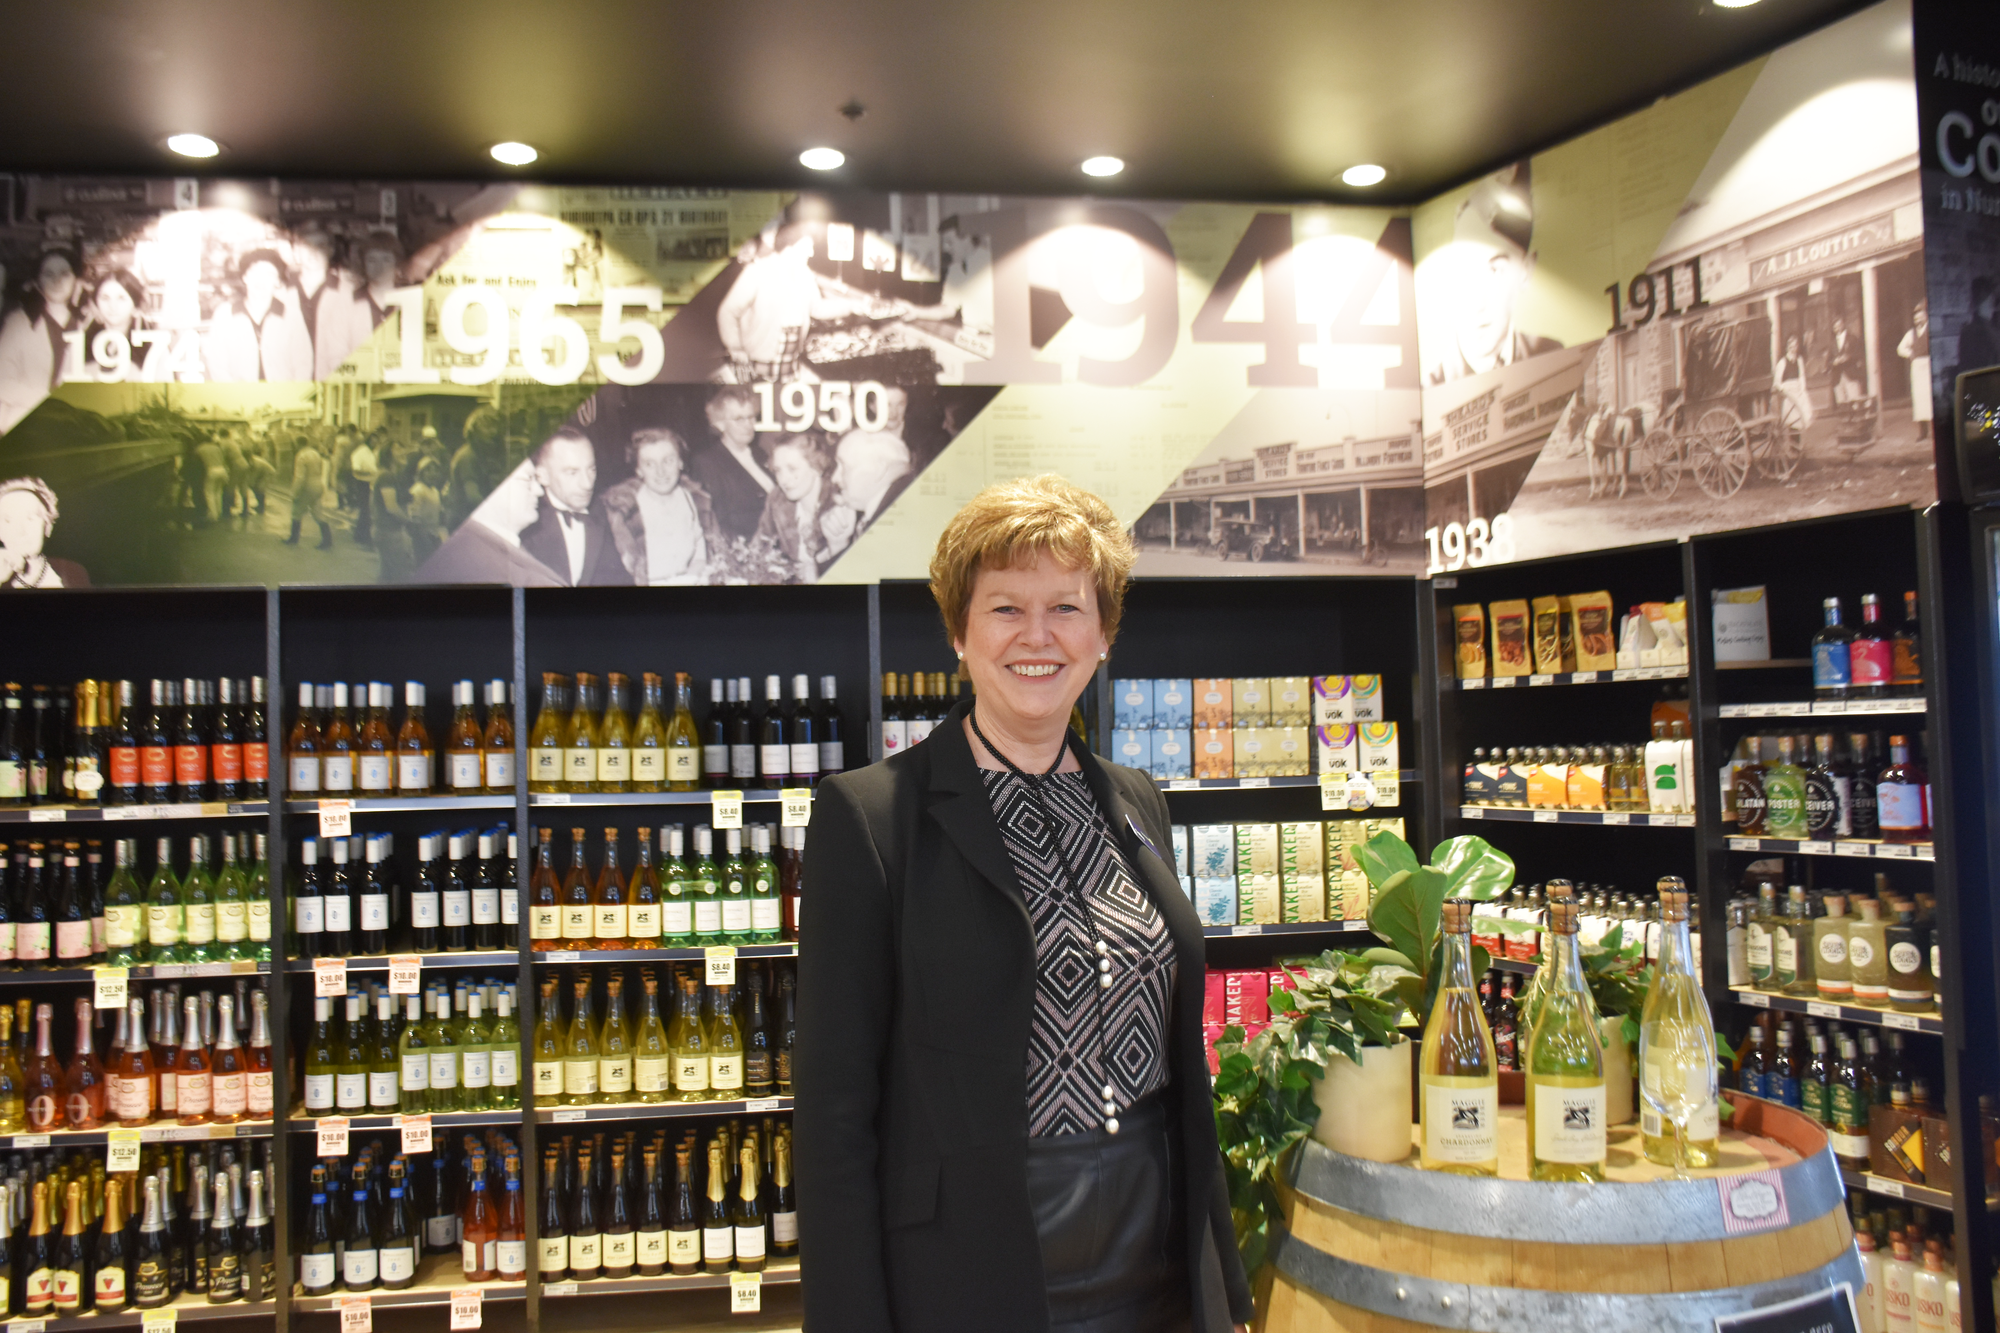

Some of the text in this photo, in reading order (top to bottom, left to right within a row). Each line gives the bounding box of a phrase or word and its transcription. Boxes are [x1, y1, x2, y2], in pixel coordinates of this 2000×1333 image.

[1933, 51, 1950, 78] A
[964, 208, 1420, 389] 1944
[1604, 257, 1709, 335] 1911
[383, 283, 666, 387] 1965
[62, 329, 205, 384] 1974
[754, 381, 889, 433] 1950
[1424, 512, 1516, 575] 1938
[1325, 710, 1344, 720] vok
[1354, 708, 1373, 718] vok
[1328, 758, 1348, 768] vok
[1370, 756, 1388, 766] vok
[1237, 829, 1252, 876] NAKED
[1283, 826, 1297, 874] NAKED
[1240, 878, 1254, 925] NAKED
[1284, 877, 1300, 924] NAKED
[1330, 874, 1343, 921] NAKED
[394, 972, 418, 980] $10.00
[712, 963, 731, 972] $8.40
[1226, 977, 1242, 1025] NAKED
[322, 1133, 346, 1142] $10.00
[405, 1130, 429, 1140] $10.00
[1440, 1138, 1493, 1146] CHARDONNAY
[112, 1148, 138, 1156] $12.50
[737, 1290, 757, 1298] $8.40
[344, 1312, 369, 1322] $10.00
[454, 1306, 479, 1315] $10.00
